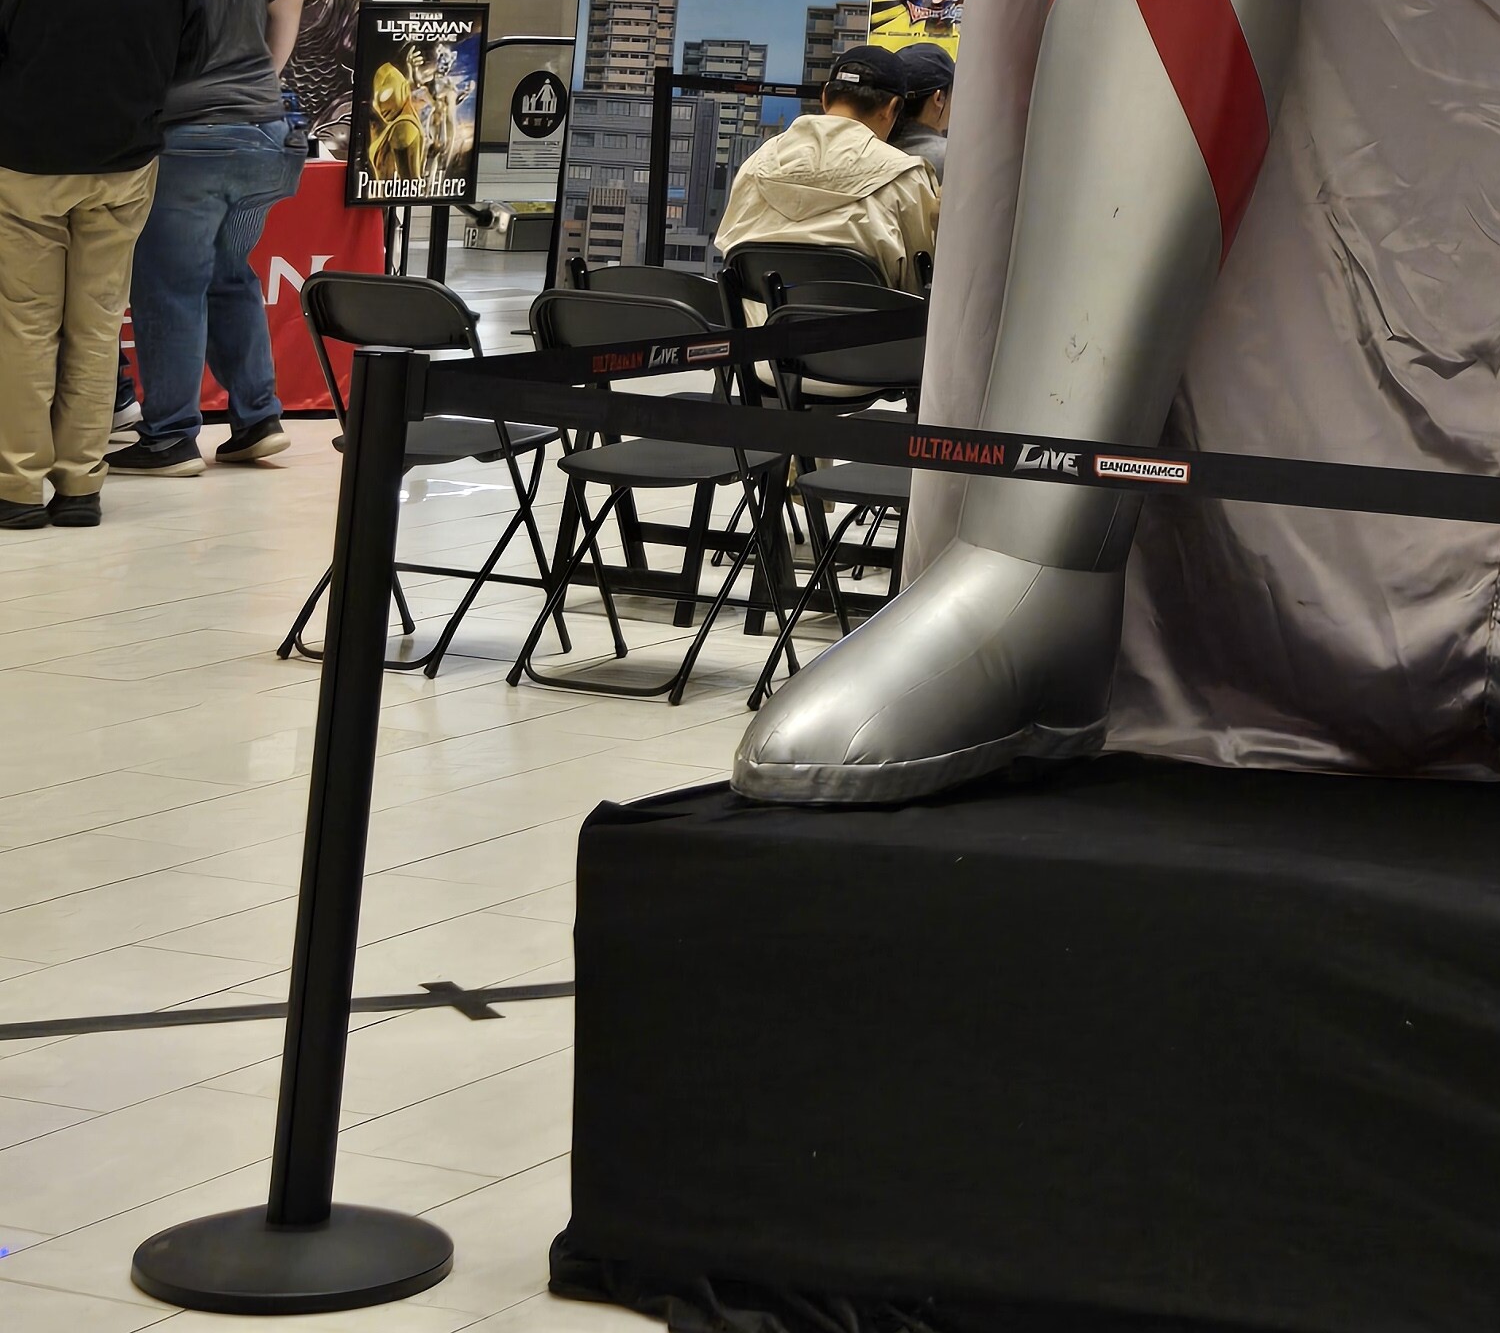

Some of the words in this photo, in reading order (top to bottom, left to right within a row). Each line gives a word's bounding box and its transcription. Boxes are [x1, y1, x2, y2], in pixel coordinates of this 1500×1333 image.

[376, 20, 473, 34] ULTRAMAN
[392, 33, 424, 41] CARD
[426, 33, 458, 42] GAME
[356, 171, 426, 199] Purchase
[430, 171, 466, 198] Here
[909, 436, 1005, 465] ULTRAMAN
[1013, 443, 1082, 477] LIVE
